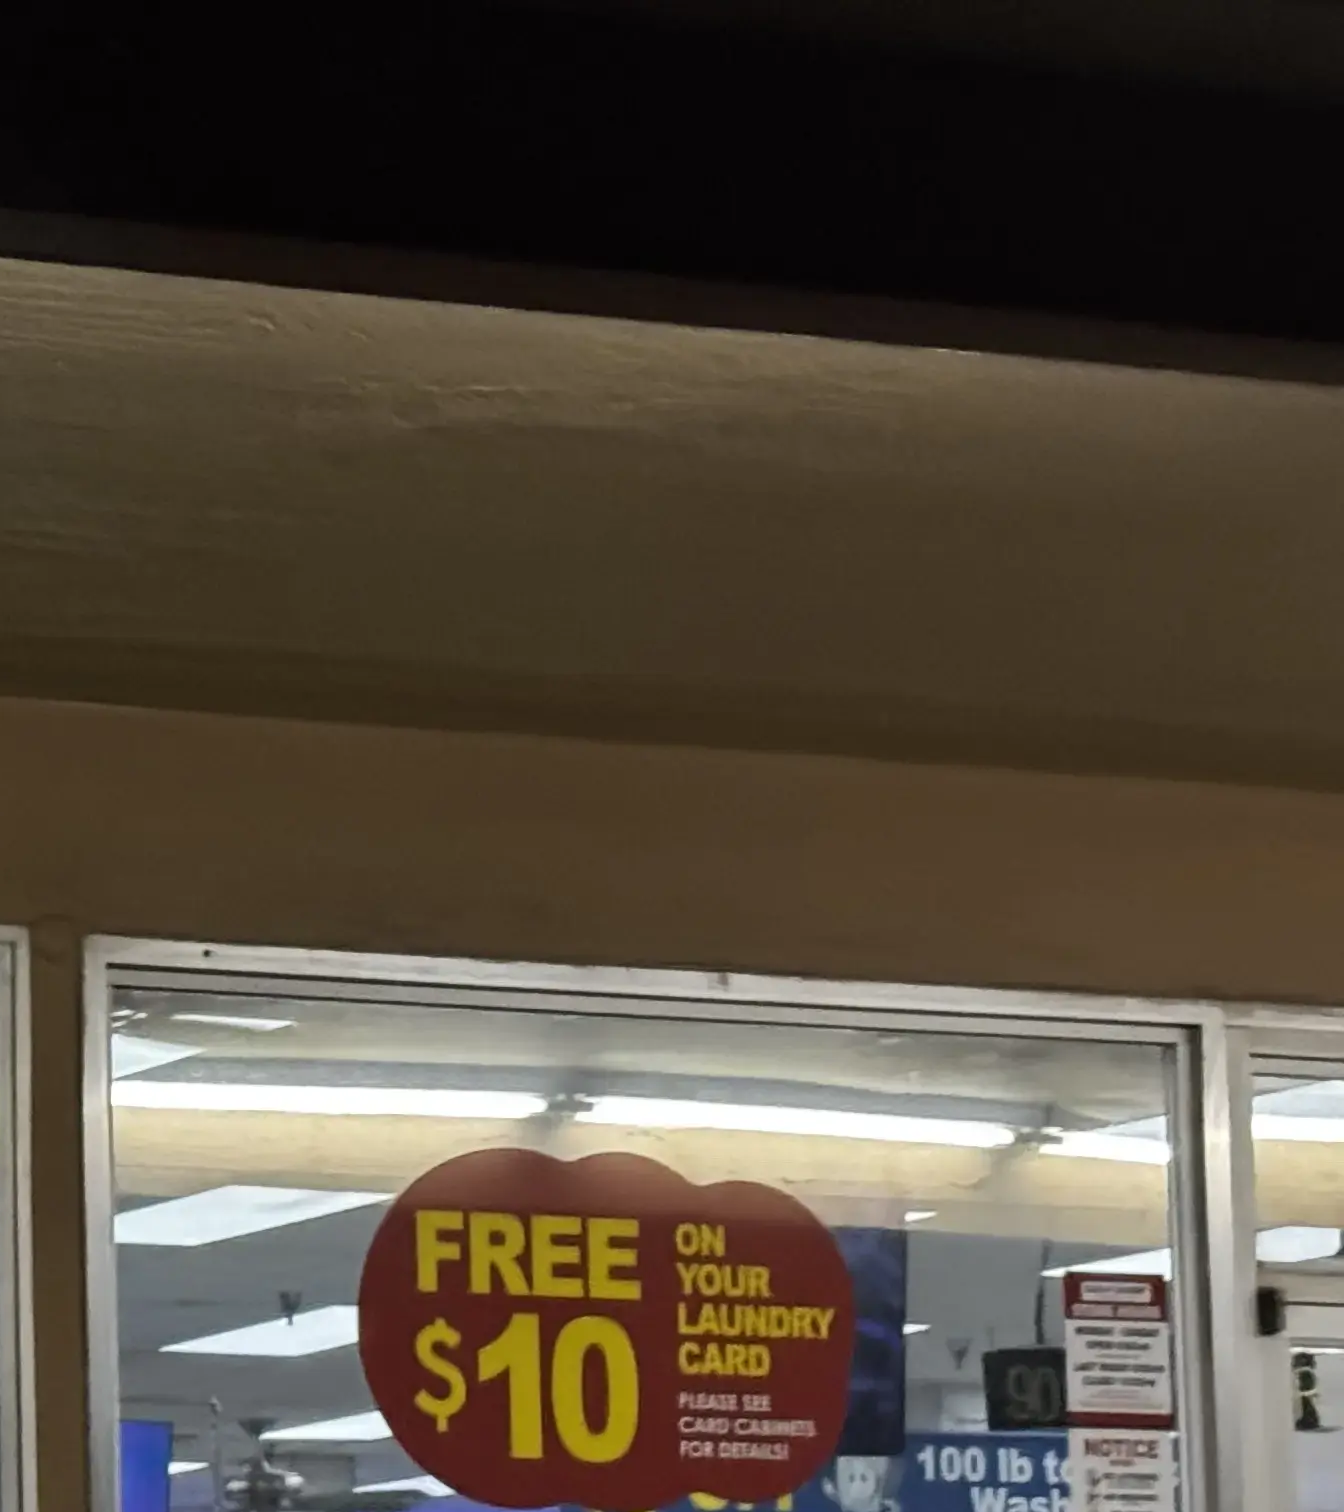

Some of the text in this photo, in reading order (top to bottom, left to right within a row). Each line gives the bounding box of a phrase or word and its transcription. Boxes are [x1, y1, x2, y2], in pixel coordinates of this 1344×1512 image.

[416, 1210, 642, 1301] FREE
[676, 1223, 727, 1257] ON
[676, 1262, 774, 1298] YOUR
[677, 1302, 836, 1339] LAUNDRY
[678, 1342, 773, 1378] CARD
[414, 1310, 642, 1464] $10
[678, 1392, 772, 1412] PLEASE SEE
[678, 1416, 730, 1434] CARD
[679, 1440, 713, 1457] FOR
[917, 1445, 987, 1482] 100
[997, 1447, 1033, 1482] lb
